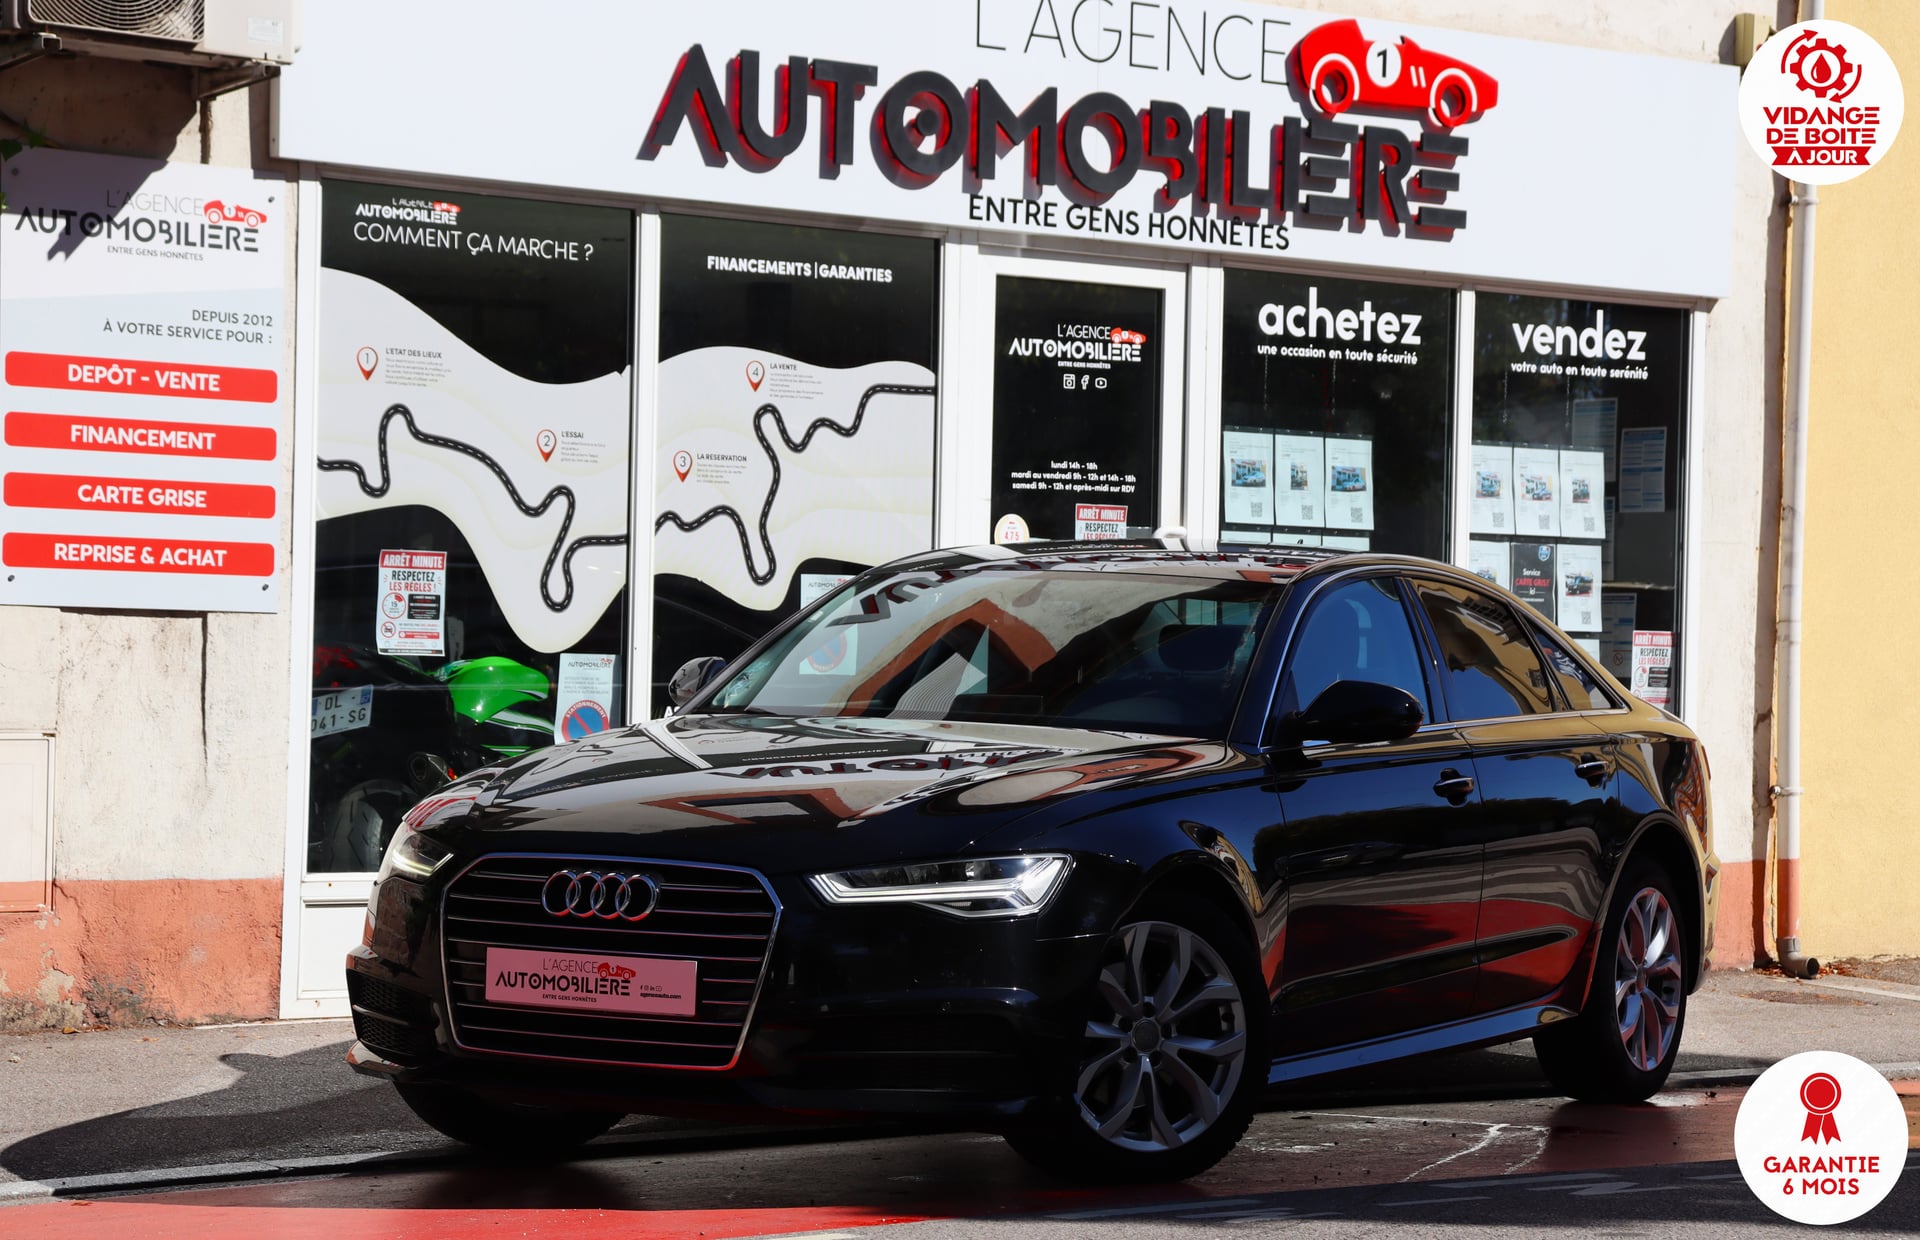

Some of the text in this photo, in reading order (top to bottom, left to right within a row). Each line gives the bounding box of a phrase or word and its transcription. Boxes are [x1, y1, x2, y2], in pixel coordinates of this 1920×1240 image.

[968, 194, 1290, 250] ENTRE GENS HONNÊTES
[353, 221, 594, 261] COMMENT ÇA MARCHE ?
[107, 245, 133, 255] ENTRE
[136, 248, 159, 257] GENS
[707, 255, 812, 277] FINANCEMENTS
[819, 263, 893, 283] GARANTIES
[192, 309, 273, 327] DEPUIS 2012
[1258, 286, 1422, 345] achetez
[103, 318, 113, 332] À
[117, 321, 163, 336] VOTRE
[167, 326, 222, 341] SERVICE
[226, 330, 264, 344] POUR
[1057, 324, 1111, 340] L'AGENCE
[1512, 309, 1647, 361] vendez
[407, 349, 421, 358] DES
[422, 350, 442, 359] LIEUX
[1257, 344, 1418, 365] une occasion en toute sécurité
[751, 366, 760, 377] 4
[769, 362, 797, 371] LA VENTE
[1511, 361, 1537, 373] votre
[1539, 363, 1563, 375] auto
[1565, 366, 1578, 376] en
[1580, 364, 1607, 377] toute
[68, 363, 136, 386] DEPÔT
[155, 370, 220, 392] VENTE
[70, 424, 216, 450] FINANCEMENT
[543, 434, 551, 447] 2
[679, 455, 687, 468] 3
[697, 453, 705, 461] LA
[1051, 459, 1068, 469] lundi
[1069, 461, 1080, 469] 14h
[1011, 470, 1032, 479] mardi
[1042, 471, 1072, 480] vendredi
[1087, 473, 1099, 481] 12h
[1107, 473, 1119, 482] 14h
[1012, 481, 1037, 490] samedi
[1053, 482, 1064, 490] 12h
[1065, 483, 1072, 491] et
[1121, 484, 1135, 493] RDV
[77, 484, 207, 508] CARTE GRISE
[1085, 522, 1119, 533] RESPECTEZ
[54, 543, 227, 568] REPRISE & ACHAT
[383, 552, 443, 569] ARRÊT MINUTE
[391, 570, 435, 582] RESPECTEZ
[1522, 567, 1541, 577] Service
[389, 581, 401, 591] LES
[325, 695, 342, 711] DL
[542, 958, 599, 974] L'AGENCE
